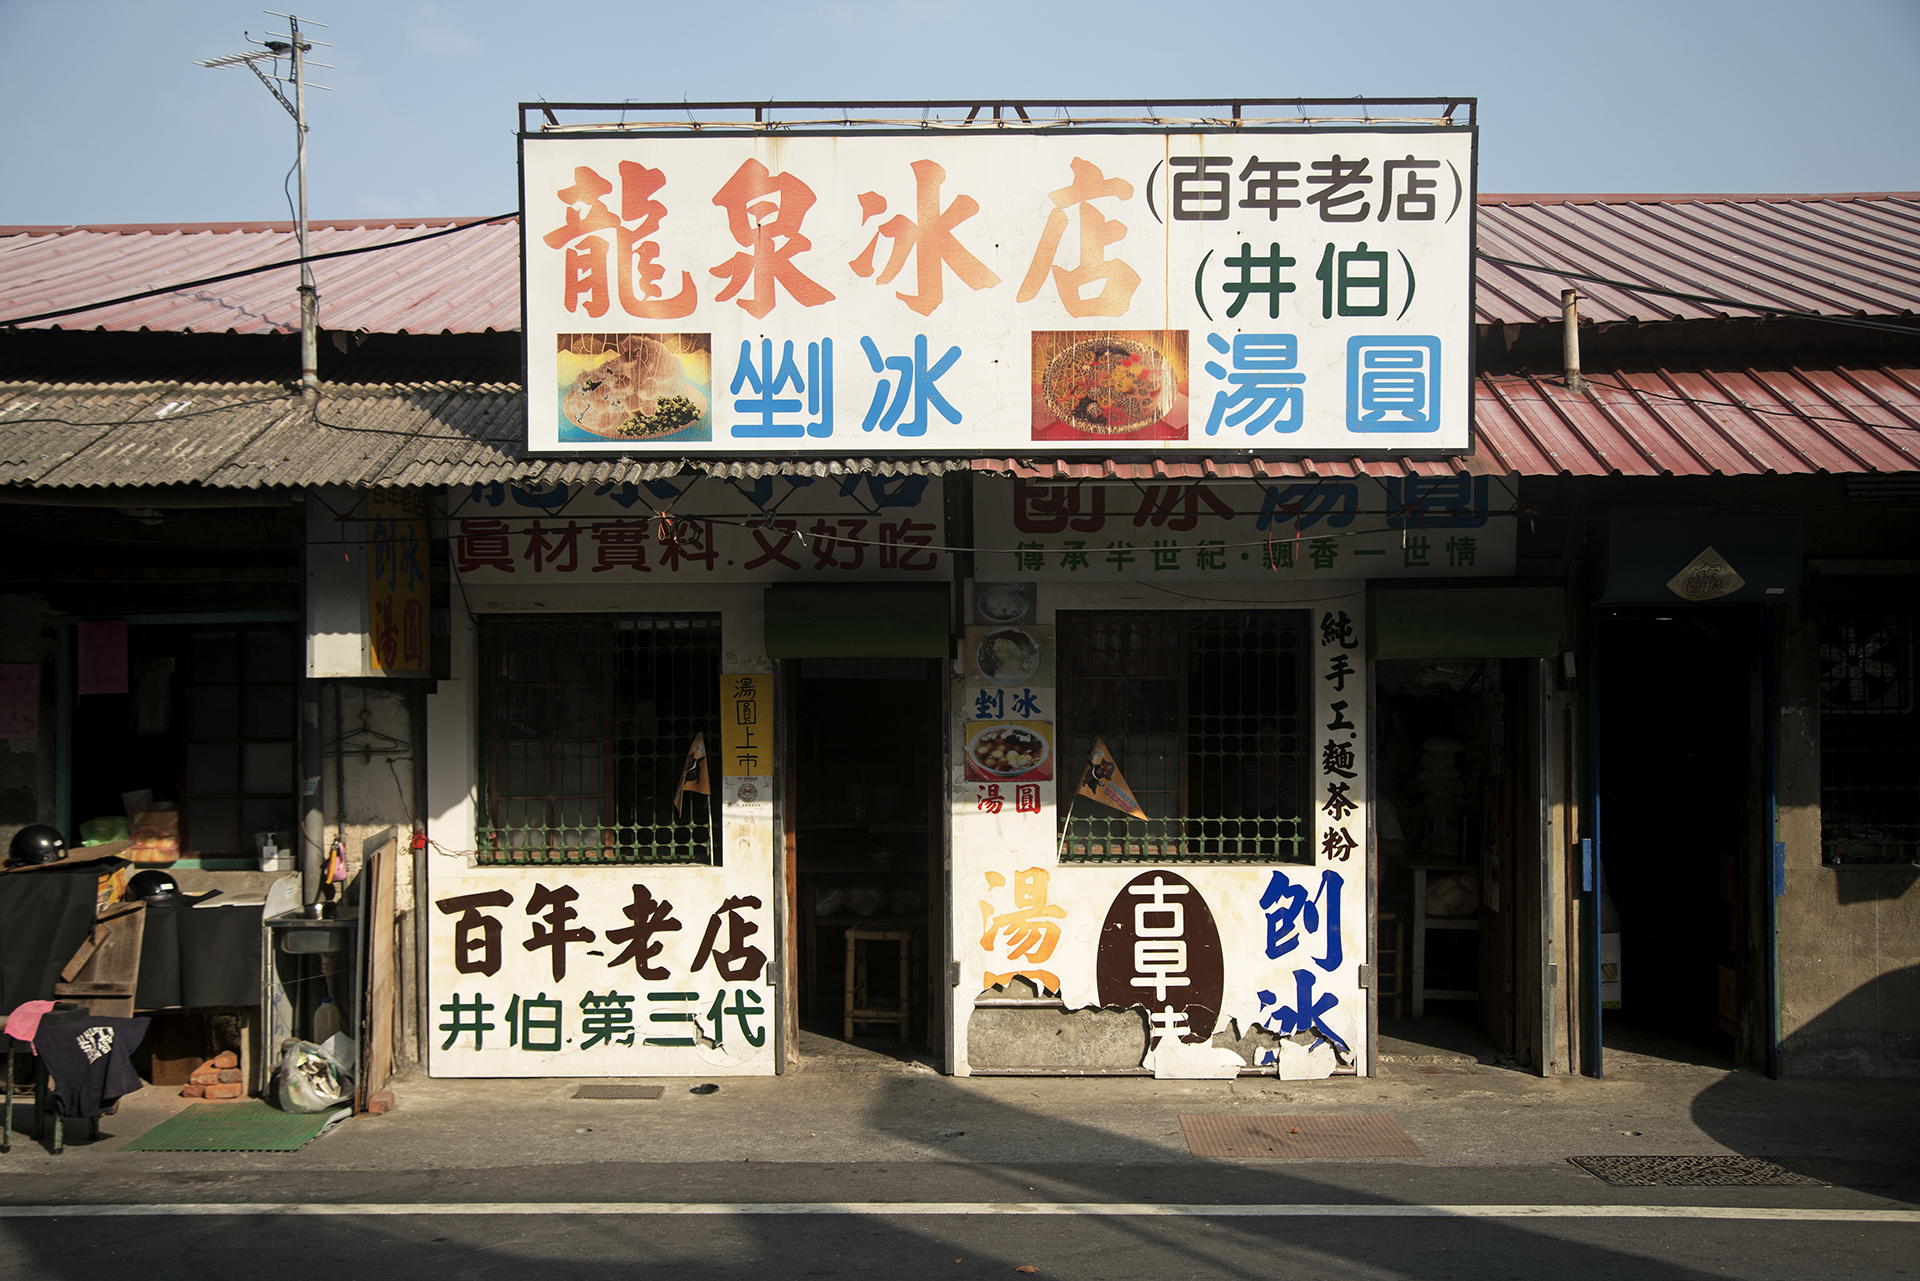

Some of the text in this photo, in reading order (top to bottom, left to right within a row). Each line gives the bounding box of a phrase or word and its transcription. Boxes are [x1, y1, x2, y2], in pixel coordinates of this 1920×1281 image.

[1146, 154, 1463, 225] (百年老店)
[543, 157, 1141, 319] 龍泉冰店
[1195, 241, 1416, 321] (井伯)
[1205, 332, 1442, 436] 湯圓
[375, 594, 423, 671] 湯圓
[733, 677, 759, 776] 湯圓上市
[977, 784, 1042, 814] 湯圓
[435, 883, 767, 983] 百年老店
[979, 866, 1068, 998] 湯
[439, 989, 766, 1051] 井伯第三代
